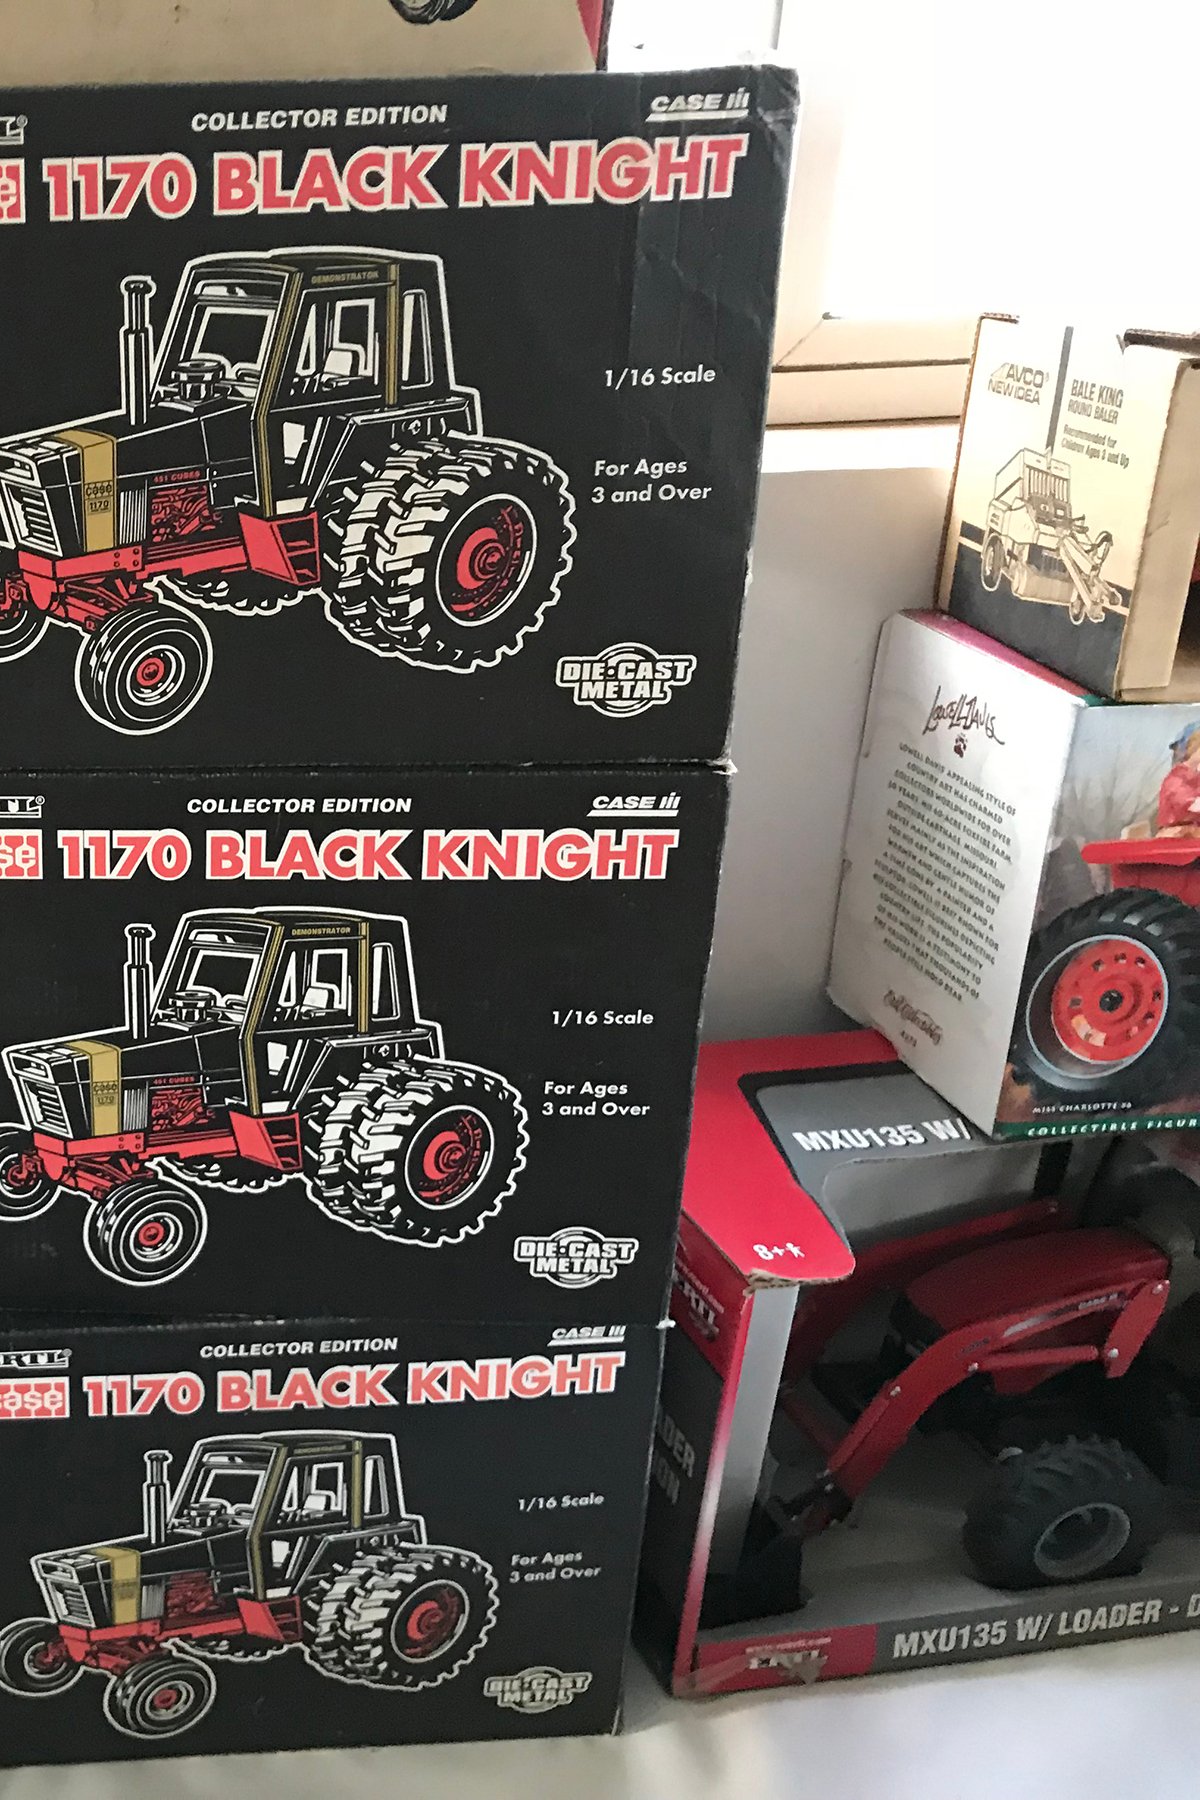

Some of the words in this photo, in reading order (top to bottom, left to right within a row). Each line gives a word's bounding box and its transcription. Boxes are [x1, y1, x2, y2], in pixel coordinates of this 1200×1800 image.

[650, 93, 723, 112] CASE
[191, 108, 338, 132] COLLECTOR
[345, 104, 448, 127] EDITION
[42, 152, 197, 221] 1170
[213, 144, 450, 216] BLACK
[458, 133, 749, 208] KNIGHT
[311, 271, 379, 284] DEMONSTRATOR
[605, 368, 655, 390] 1/16
[661, 364, 716, 385] Scale
[1005, 363, 1045, 388] AVCO
[988, 378, 1013, 394] NEW
[1014, 384, 1040, 405] IDEA
[1071, 379, 1096, 401] BALE
[1097, 385, 1123, 408] KING
[1068, 399, 1092, 417] ROUND
[1094, 406, 1118, 424] BALER
[594, 460, 629, 476] For
[634, 458, 688, 479] Ages
[85, 483, 113, 498] case
[591, 486, 605, 503] 3
[611, 484, 652, 502] and
[658, 484, 712, 501] Over
[89, 501, 109, 510] 1170
[581, 681, 664, 699] METAL
[945, 768, 984, 798] APPEALING
[984, 791, 1006, 811] STYLE
[187, 798, 314, 814] COLLECTOR
[322, 798, 412, 813] EDITION
[592, 796, 656, 810] CASE
[967, 796, 1003, 825] CHARMED
[990, 826, 1012, 847] OVER
[57, 828, 192, 881] 1170
[205, 829, 413, 880] BLACK
[421, 828, 680, 881] KNIGHT
[292, 927, 351, 936] DEMONSTRATOR
[552, 1009, 598, 1027] 1/16
[603, 1009, 654, 1025] Scale
[544, 1081, 575, 1095] For
[580, 1081, 628, 1098] Ages
[542, 1102, 554, 1116] 3
[559, 1101, 596, 1116] and
[601, 1102, 650, 1116] Over
[1032, 1103, 1055, 1114] MISS
[1059, 1101, 1117, 1113] CHARLOTTE
[792, 1123, 925, 1152] MXU135
[922, 1116, 972, 1141] W/
[1028, 1121, 1137, 1137] COLLECTIBLE
[536, 1257, 611, 1273] METAL
[552, 1326, 606, 1339] CASE
[200, 1341, 314, 1358] COLLECTOR
[320, 1337, 399, 1354] EDITION
[82, 1370, 205, 1417] 1170
[217, 1362, 400, 1413] BLACK
[406, 1351, 626, 1405] KNIGHT
[519, 1496, 557, 1512] 1/16
[561, 1492, 604, 1508] Scale
[511, 1554, 538, 1566] For
[542, 1552, 582, 1566] Ages
[510, 1571, 520, 1583] 3
[524, 1568, 556, 1581] and
[560, 1567, 601, 1579] Over
[892, 1620, 1008, 1659] MXU135
[1015, 1613, 1053, 1643] W/
[1057, 1599, 1163, 1636] LOADER
[503, 1690, 569, 1702] METAL
